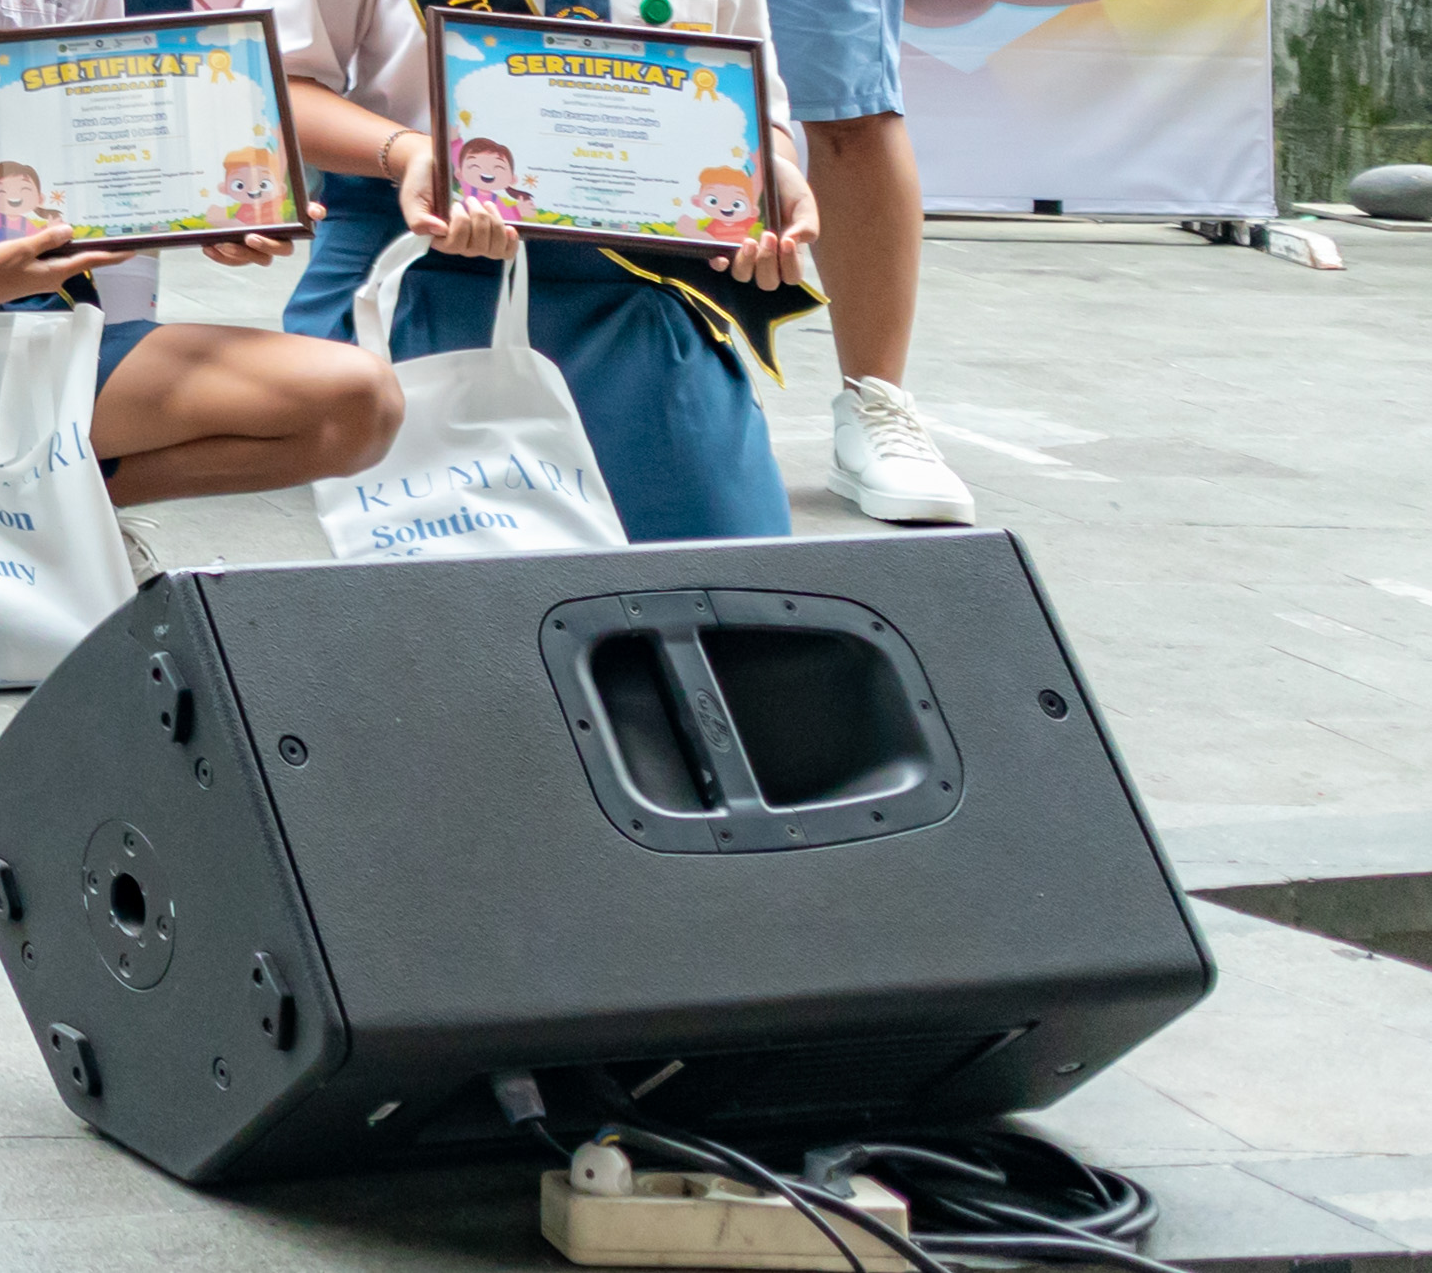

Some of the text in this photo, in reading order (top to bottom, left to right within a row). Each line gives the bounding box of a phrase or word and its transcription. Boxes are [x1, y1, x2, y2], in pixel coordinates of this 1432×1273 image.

[21, 54, 202, 92] SERTIFIKAT
[506, 54, 688, 91] SERTIFIKAT
[355, 454, 591, 513] KUMARI
[371, 507, 518, 547] Solution
